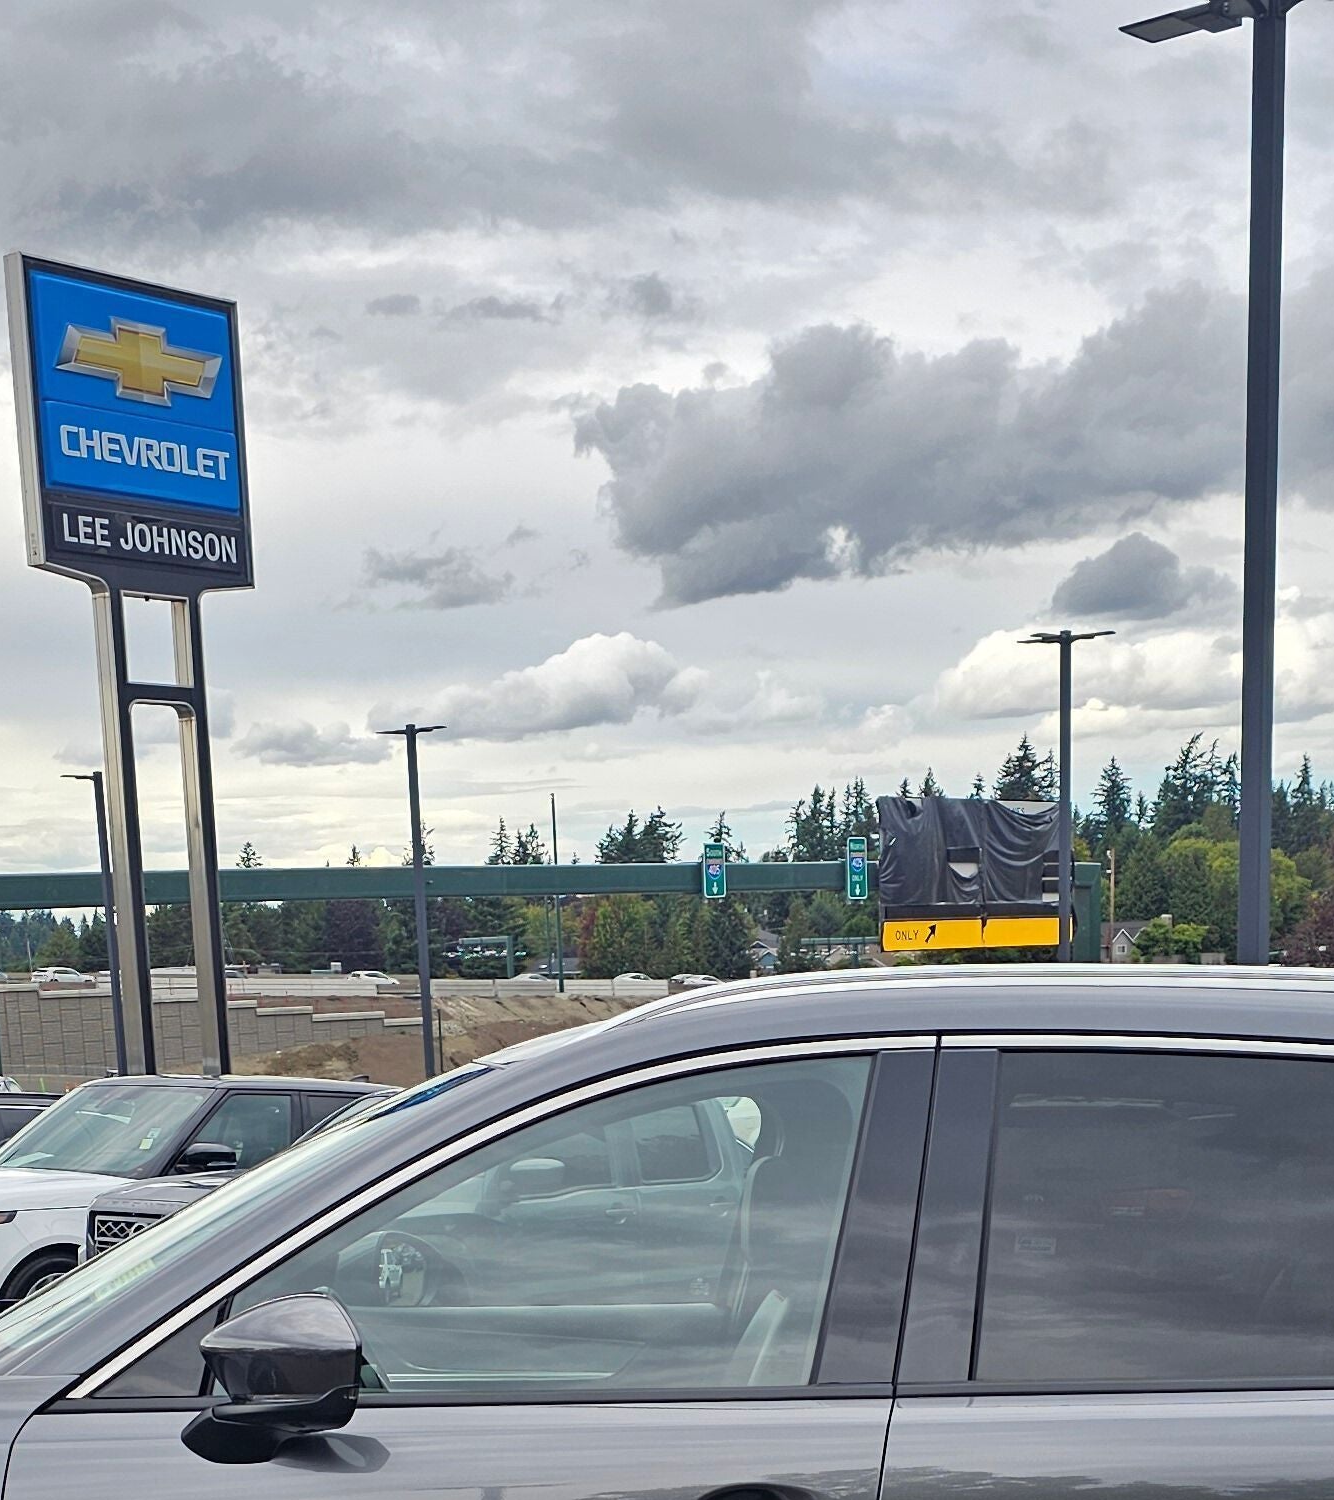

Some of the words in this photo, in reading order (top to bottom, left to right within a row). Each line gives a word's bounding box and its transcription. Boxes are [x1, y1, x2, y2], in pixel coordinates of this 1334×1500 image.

[59, 424, 230, 481] CHEVROLET
[62, 512, 112, 547] LEE
[119, 521, 237, 564] JOHNSON
[894, 929, 919, 941] ONLY
